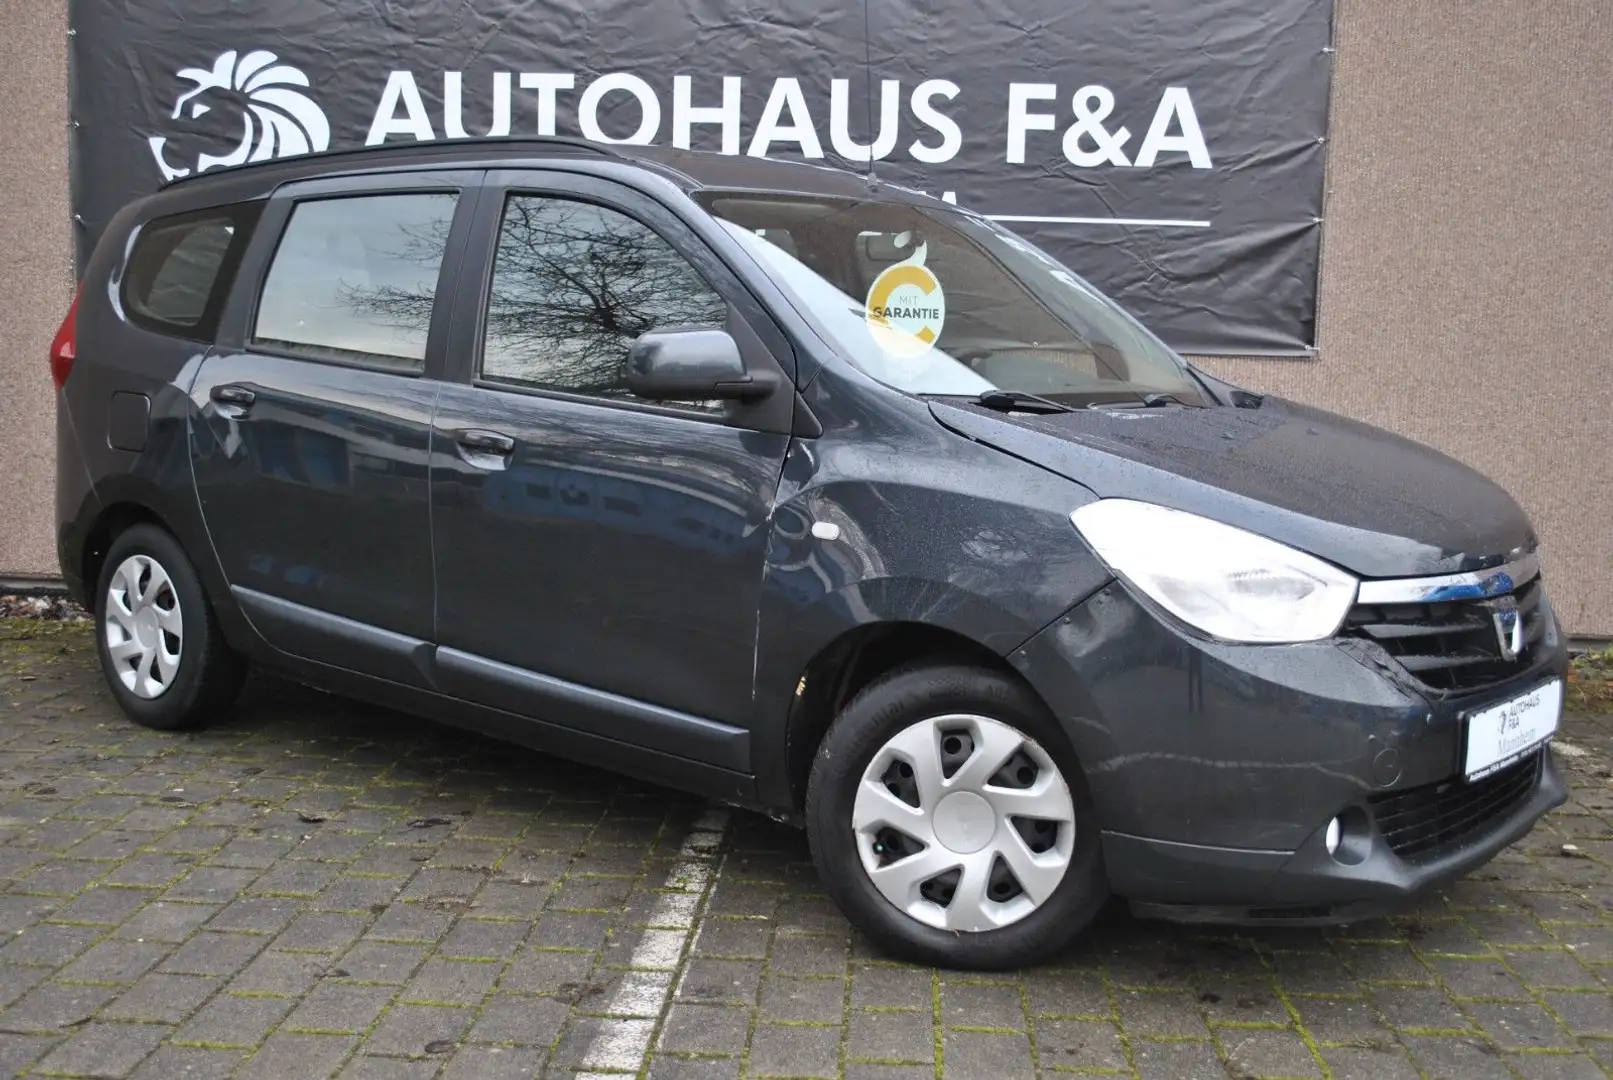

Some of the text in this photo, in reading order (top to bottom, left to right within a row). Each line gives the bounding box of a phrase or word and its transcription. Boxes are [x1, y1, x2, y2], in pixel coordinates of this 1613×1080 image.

[364, 70, 1213, 169] AUTOHAUS F&A
[899, 295, 919, 306] MIT
[873, 307, 940, 319] GARANTIE
[1509, 693, 1540, 717] AUTOHAUS
[1497, 728, 1536, 756] Mannheim
